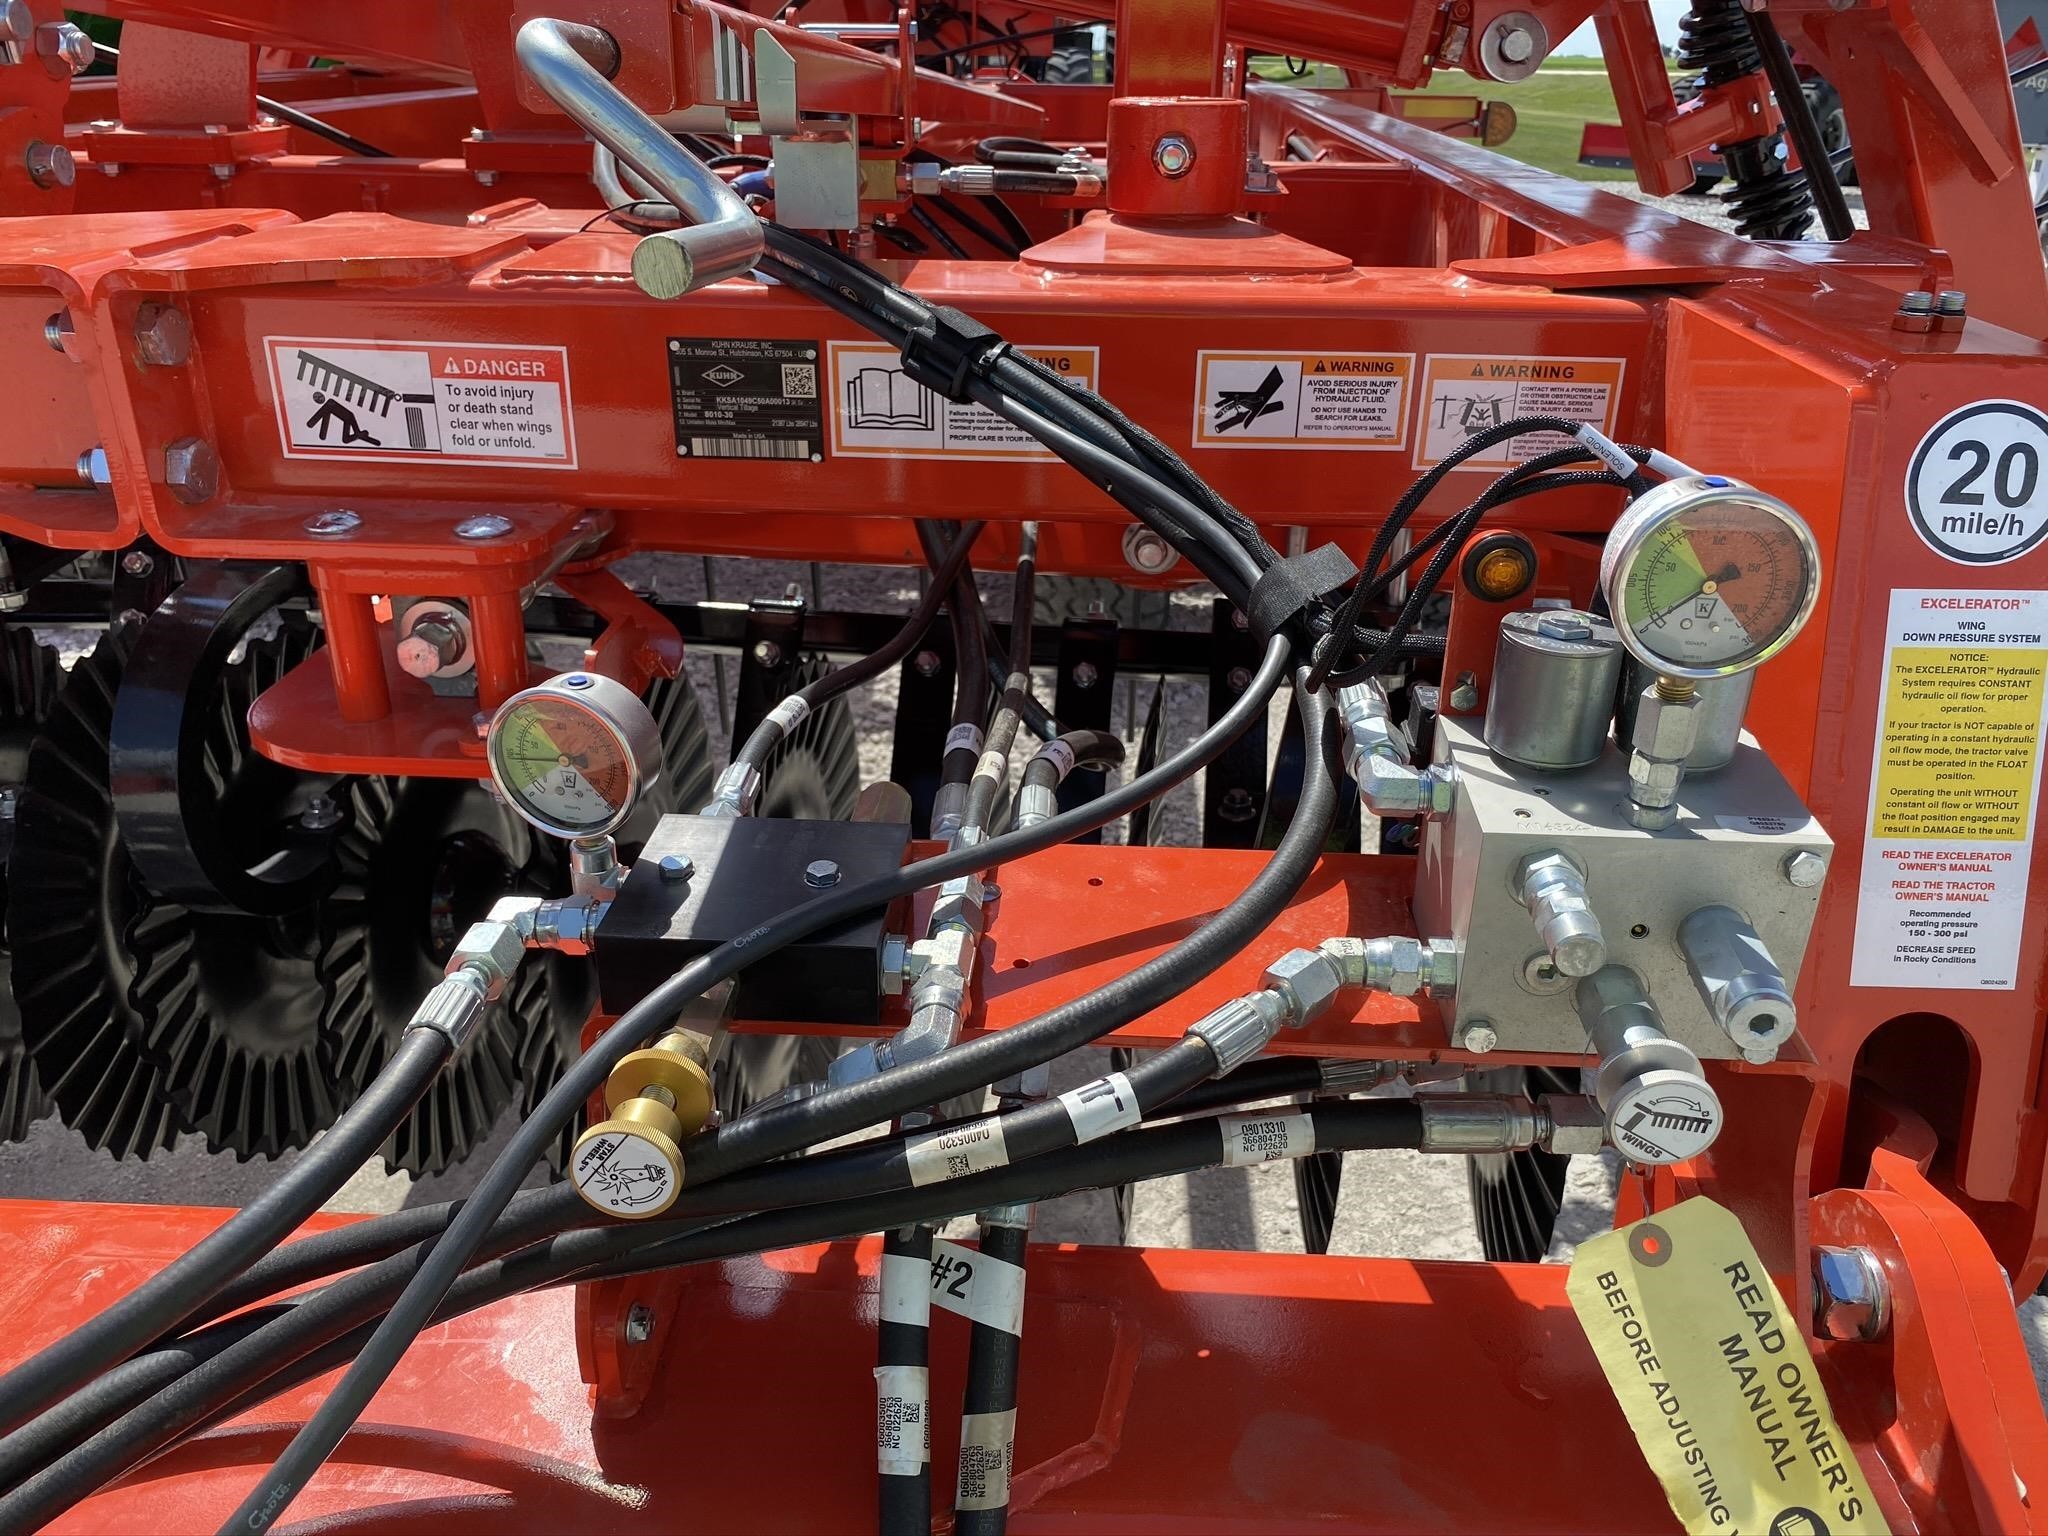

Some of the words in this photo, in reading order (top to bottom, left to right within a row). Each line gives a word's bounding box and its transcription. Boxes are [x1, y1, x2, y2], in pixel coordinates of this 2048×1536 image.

[464, 359, 545, 376] DANGER
[1331, 361, 1394, 372] WARNING
[1490, 365, 1574, 378] WARNING
[446, 384, 461, 395] To
[465, 386, 496, 397] avoid
[501, 387, 534, 401] injury
[449, 404, 460, 412] or
[464, 402, 496, 413] death
[501, 405, 533, 415] stand
[451, 418, 478, 429] clear
[482, 419, 513, 430] when
[517, 421, 552, 435] wings
[453, 434, 474, 446] fold
[479, 438, 490, 446] or
[495, 437, 535, 448] unfold.
[1585, 436, 1625, 471] SOLENOID
[1939, 439, 2039, 508] 20
[1941, 512, 2024, 536] mile/h
[1665, 562, 1677, 573] 50
[1958, 621, 1986, 630] WING
[1902, 633, 1935, 642] DOWN
[1938, 634, 1995, 642] PRESSURE
[1998, 634, 2041, 643] SYSTEM
[1896, 666, 1913, 674] The
[1996, 668, 2040, 676] Hydraulic
[1902, 679, 1935, 687] System
[1938, 680, 1976, 689] requires
[1978, 680, 2032, 688] CONSTANT
[1902, 692, 1944, 701] hydraulic
[1997, 695, 2028, 703] proper
[1940, 705, 1986, 714] operation.
[1987, 723, 2022, 732] capable
[530, 741, 538, 749] 50
[1886, 735, 1929, 744] operating
[1992, 736, 2035, 745] hydraulic
[1924, 748, 1952, 756] mode,
[1926, 760, 1966, 769] operated
[1968, 760, 1977, 768] in
[1980, 760, 1994, 768] the
[1996, 760, 2027, 768] FLOAT
[1935, 773, 1975, 782] position.
[1890, 788, 1934, 797] Operating
[1954, 789, 1971, 797] unit
[1974, 790, 2018, 798] WITHOUT
[1975, 802, 2019, 810] WITHOUT
[1920, 814, 1958, 823] position
[1960, 814, 1999, 823] engaged
[2001, 816, 2020, 824] may
[1923, 826, 1965, 834] DAMAGE
[1995, 827, 2015, 835] unit.
[1882, 851, 1910, 859] READ
[1914, 851, 1934, 859] THE
[1936, 852, 2012, 861] EXCELERATOR
[1898, 863, 1947, 871] OWNER'S
[1950, 863, 1992, 872] MANUAL
[1892, 881, 1920, 889] READ
[1923, 881, 1943, 890] THE
[1946, 882, 1995, 890] TRACTOR
[1895, 892, 1943, 900] OWNER'S
[1946, 893, 1990, 901] MANUAL
[1909, 910, 1971, 918] Recommended
[1900, 920, 1943, 928] operating
[1941, 921, 1978, 929] pressure
[1953, 930, 1968, 938] psi
[1904, 956, 1929, 964] Rocky
[1931, 956, 1976, 964] Conditions
[1242, 1121, 1286, 1136] Q8013310
[1242, 1133, 1288, 1145] 366804795
[1243, 1144, 1255, 1152] NC
[1258, 1142, 1288, 1151] 022620
[1622, 1132, 1662, 1158] WINGS
[596, 1143, 615, 1161] STAR
[931, 1253, 973, 1299] #2
[1723, 1260, 1786, 1354] READ
[1777, 1362, 1863, 1523] OWNER'S
[1596, 1270, 1661, 1376] BEFORE
[1649, 1381, 1731, 1526] ADJUSTING
[1718, 1333, 1797, 1482] MANUAL
[893, 1397, 902, 1432] 022620
[878, 1397, 887, 1447] Q6003500
[885, 1397, 894, 1449] 366804763
[892, 1435, 900, 1449] NC
[976, 1445, 984, 1480] 022620
[960, 1447, 969, 1497] Q6003500
[969, 1446, 977, 1498] 366804763
[978, 1483, 985, 1498] NC
